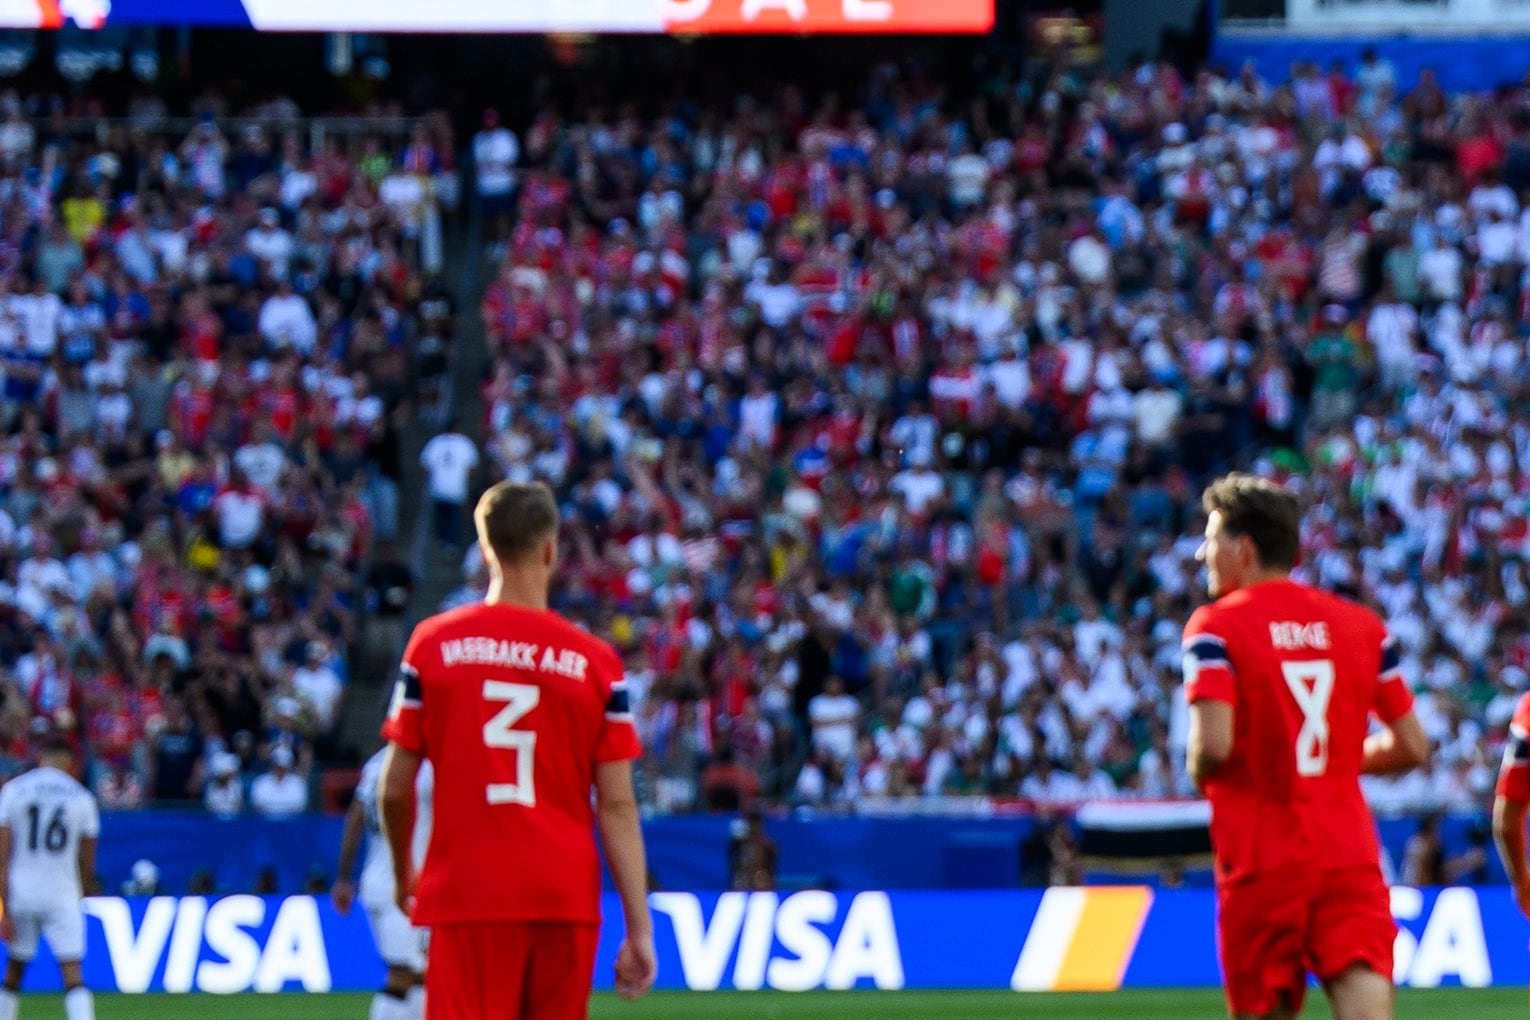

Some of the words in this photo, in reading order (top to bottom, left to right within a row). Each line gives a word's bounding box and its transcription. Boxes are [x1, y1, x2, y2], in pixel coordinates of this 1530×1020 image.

[539, 645, 589, 683] AJER
[482, 679, 541, 808] 3
[1281, 659, 1336, 777] 8
[25, 803, 69, 854] 16
[83, 895, 332, 993] VISA
[649, 889, 904, 990] VISA
